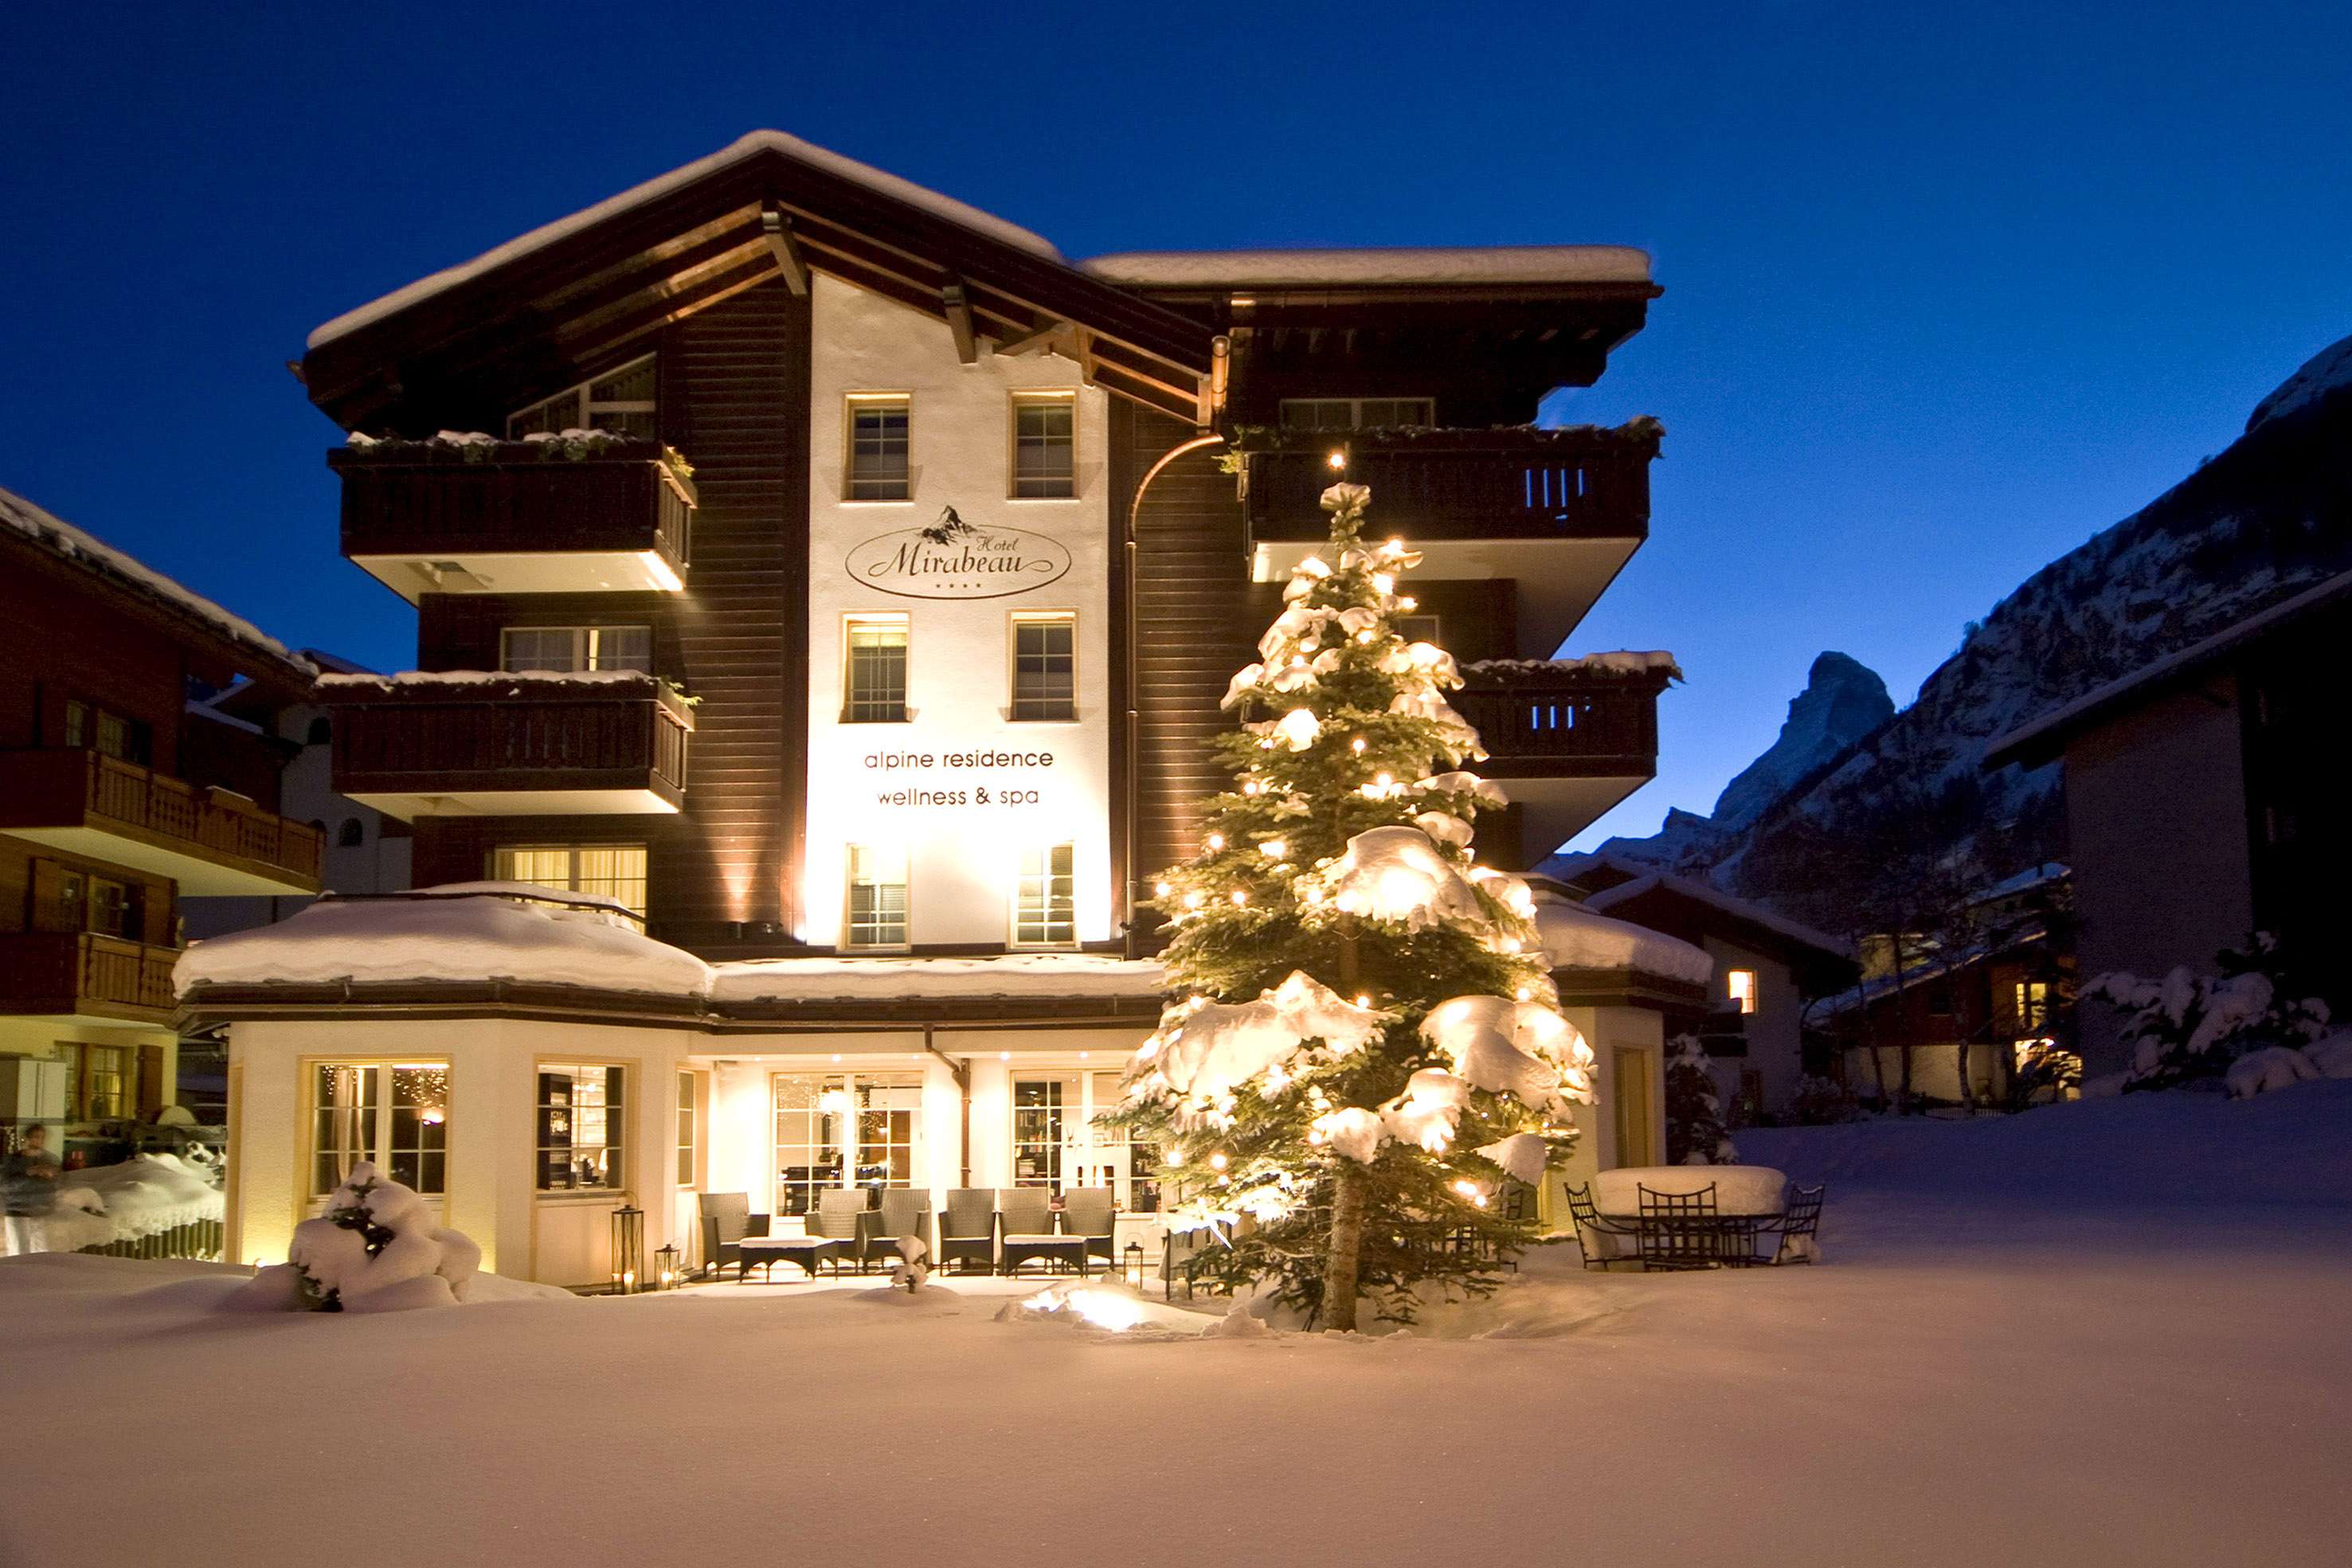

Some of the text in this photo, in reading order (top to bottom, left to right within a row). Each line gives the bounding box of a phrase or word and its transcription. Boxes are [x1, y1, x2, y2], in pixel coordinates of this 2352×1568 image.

[976, 536, 1019, 552] Hotel
[868, 542, 1053, 577] Mirabeau
[864, 749, 1054, 772] alpine residence
[878, 787, 1039, 807] wellness & spa
